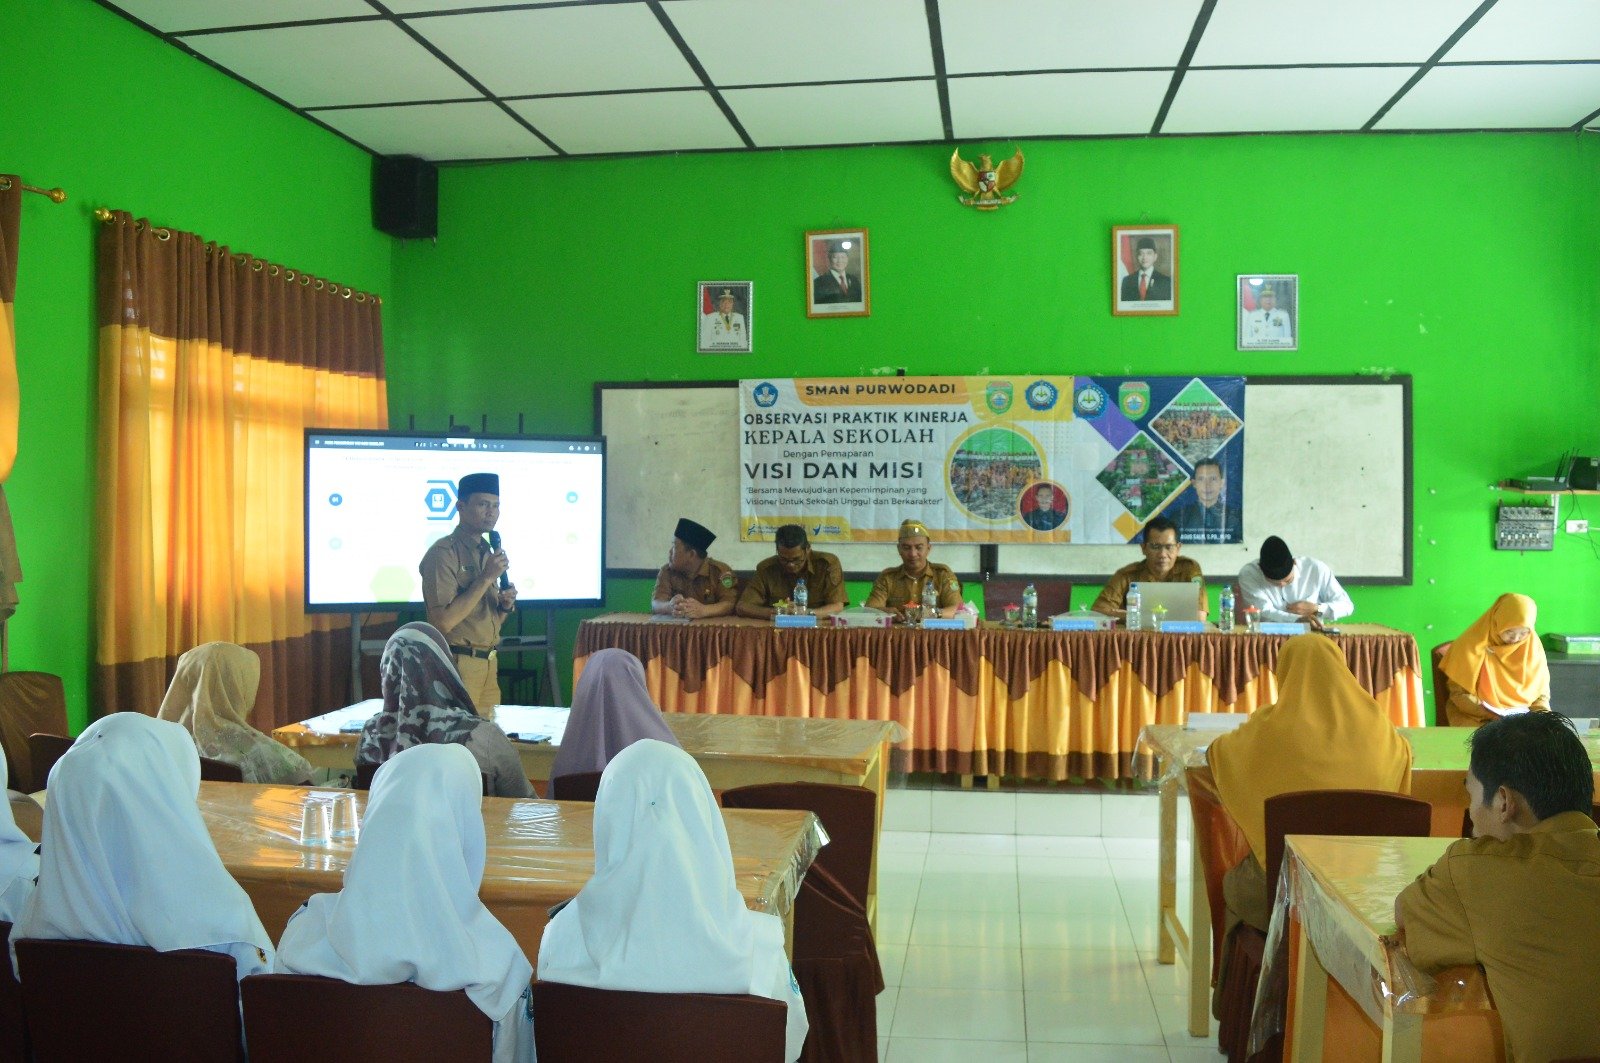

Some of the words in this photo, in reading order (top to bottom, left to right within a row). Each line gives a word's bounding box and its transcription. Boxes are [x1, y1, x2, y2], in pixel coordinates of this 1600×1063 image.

[805, 385, 849, 396] SMAN
[856, 383, 956, 395] PURWODADI
[744, 413, 827, 425] OBSERVASI
[833, 411, 898, 424] PRAKTIK
[904, 411, 968, 423] KINERJA
[744, 430, 826, 444] KEPALA
[833, 428, 934, 444] SEKOLAH
[783, 450, 818, 459] Dengan
[821, 450, 874, 459] Pemaparan
[744, 462, 792, 479] VISI
[803, 462, 857, 479] DAN
[869, 462, 922, 479] MISI
[784, 486, 838, 495] Mewujudkan
[839, 486, 905, 495] Kepemimpinan
[906, 487, 927, 495] yang
[841, 498, 871, 507] Unggul
